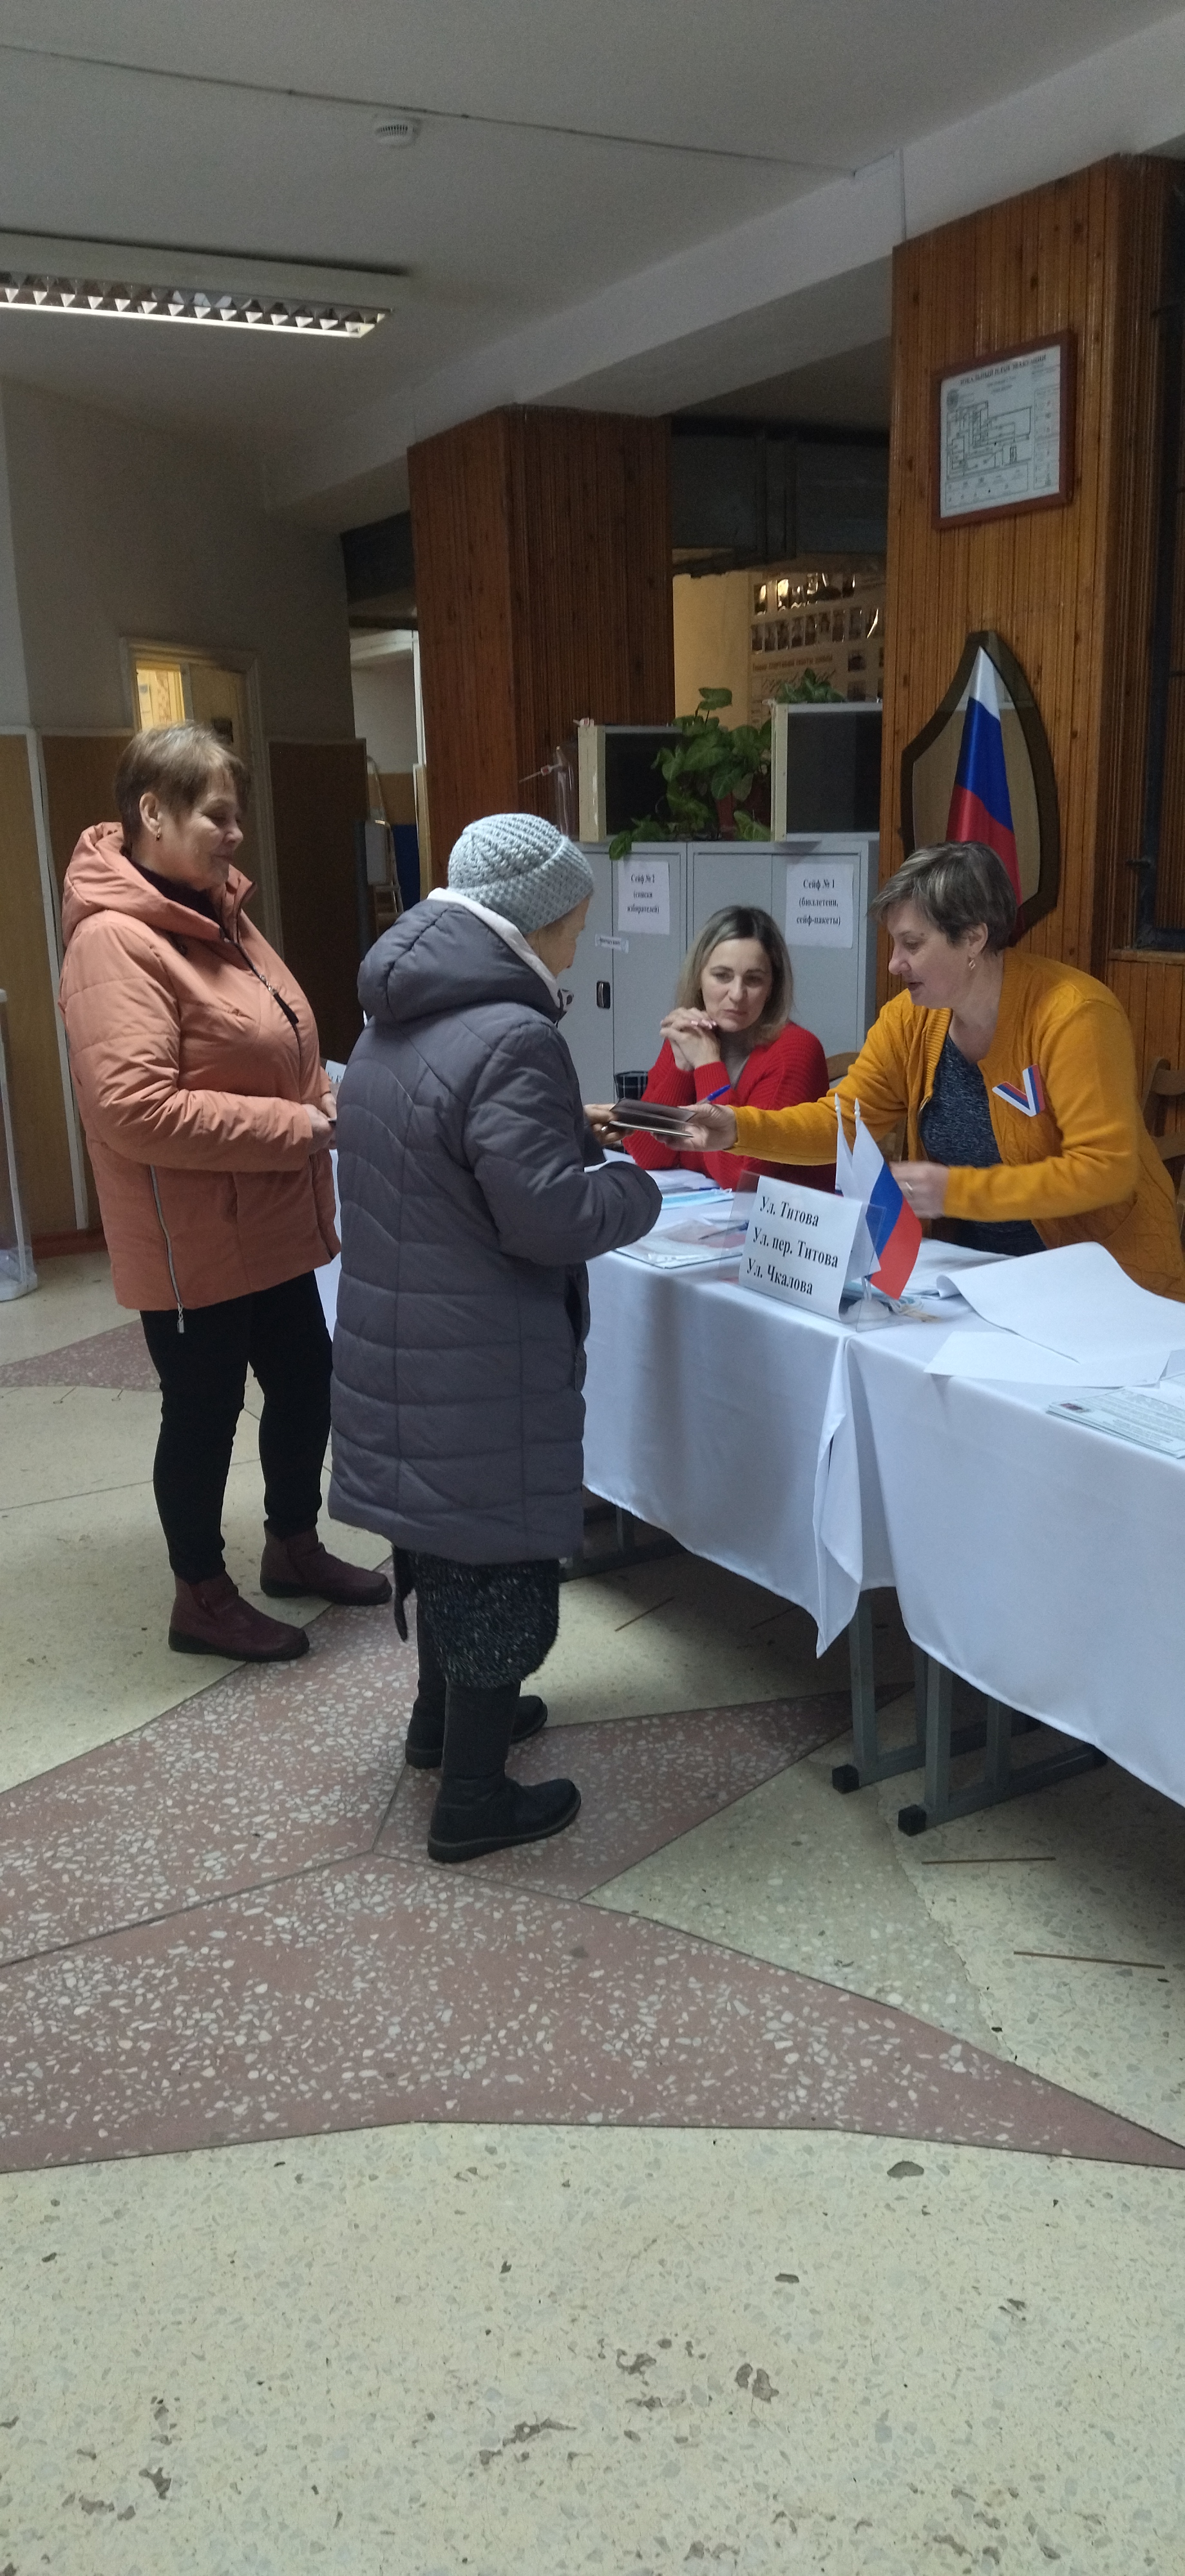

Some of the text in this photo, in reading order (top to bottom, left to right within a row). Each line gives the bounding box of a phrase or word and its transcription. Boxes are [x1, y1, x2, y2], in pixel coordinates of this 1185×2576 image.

[631, 874, 645, 886] Сейф
[652, 874, 655, 883] 2
[802, 878, 821, 891] Сейф
[823, 878, 830, 889] №
[633, 891, 653, 900] (списки
[799, 896, 839, 908] (бюллетени,
[796, 914, 841, 927] сейф-пакеты)
[759, 1196, 819, 1227] Ул. Титова
[753, 1226, 838, 1268] Ул. пер. Титова
[746, 1258, 813, 1296] Ул. Чкалова
